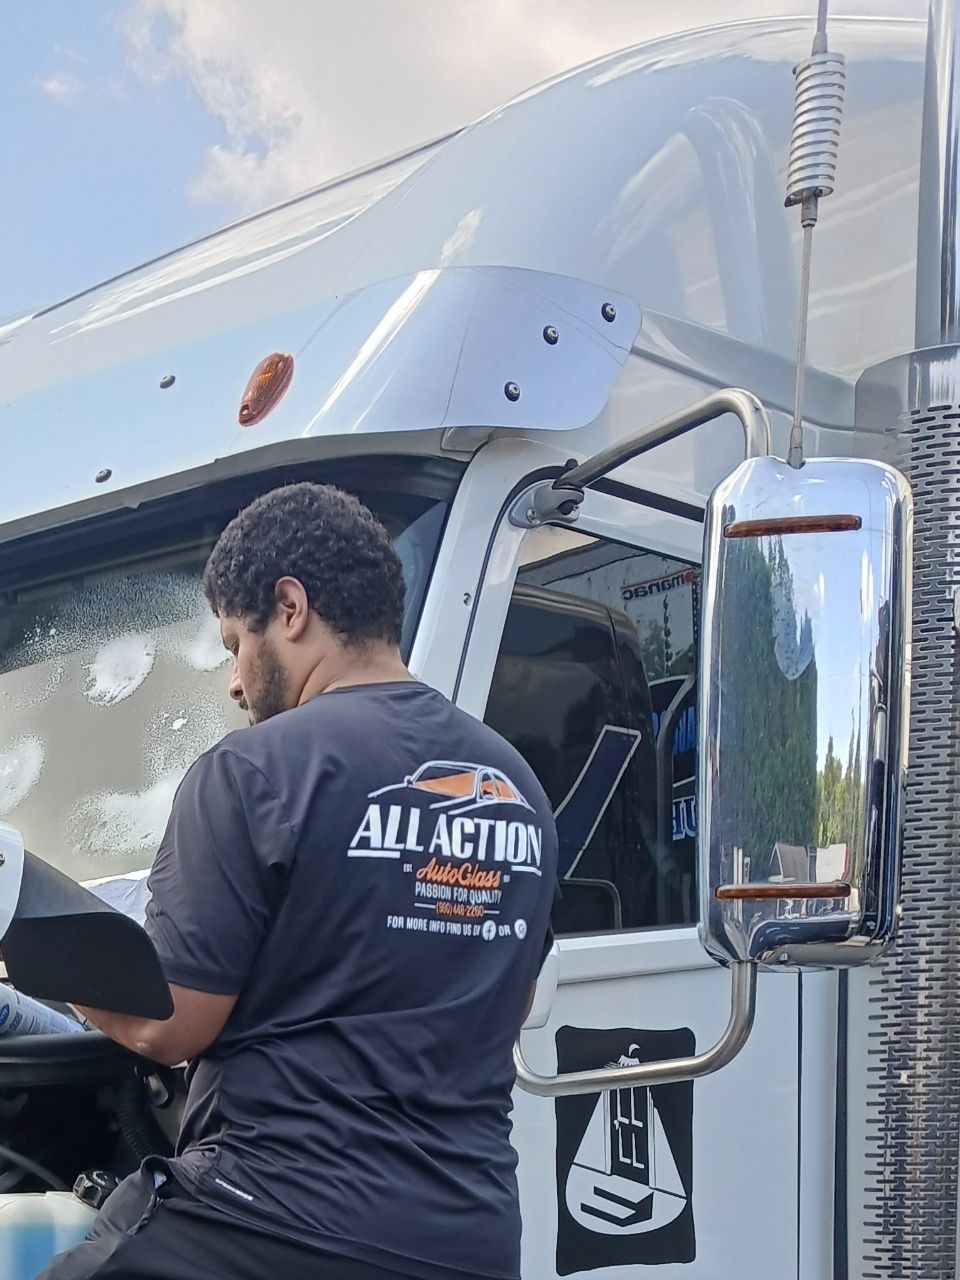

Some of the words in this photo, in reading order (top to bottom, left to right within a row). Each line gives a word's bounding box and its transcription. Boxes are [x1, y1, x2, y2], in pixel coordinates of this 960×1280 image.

[349, 804, 424, 852] ALL
[429, 813, 542, 866] ACTION
[416, 857, 502, 888] AutoGlass
[415, 881, 452, 901] PASSION
[453, 888, 468, 903] FOR
[469, 889, 503, 905] QUALITY
[387, 915, 404, 929] FOR
[406, 917, 428, 931] MORE
[429, 920, 446, 933] INFO
[446, 922, 462, 935] FIND
[463, 923, 472, 936] US
[498, 924, 511, 937] OR
